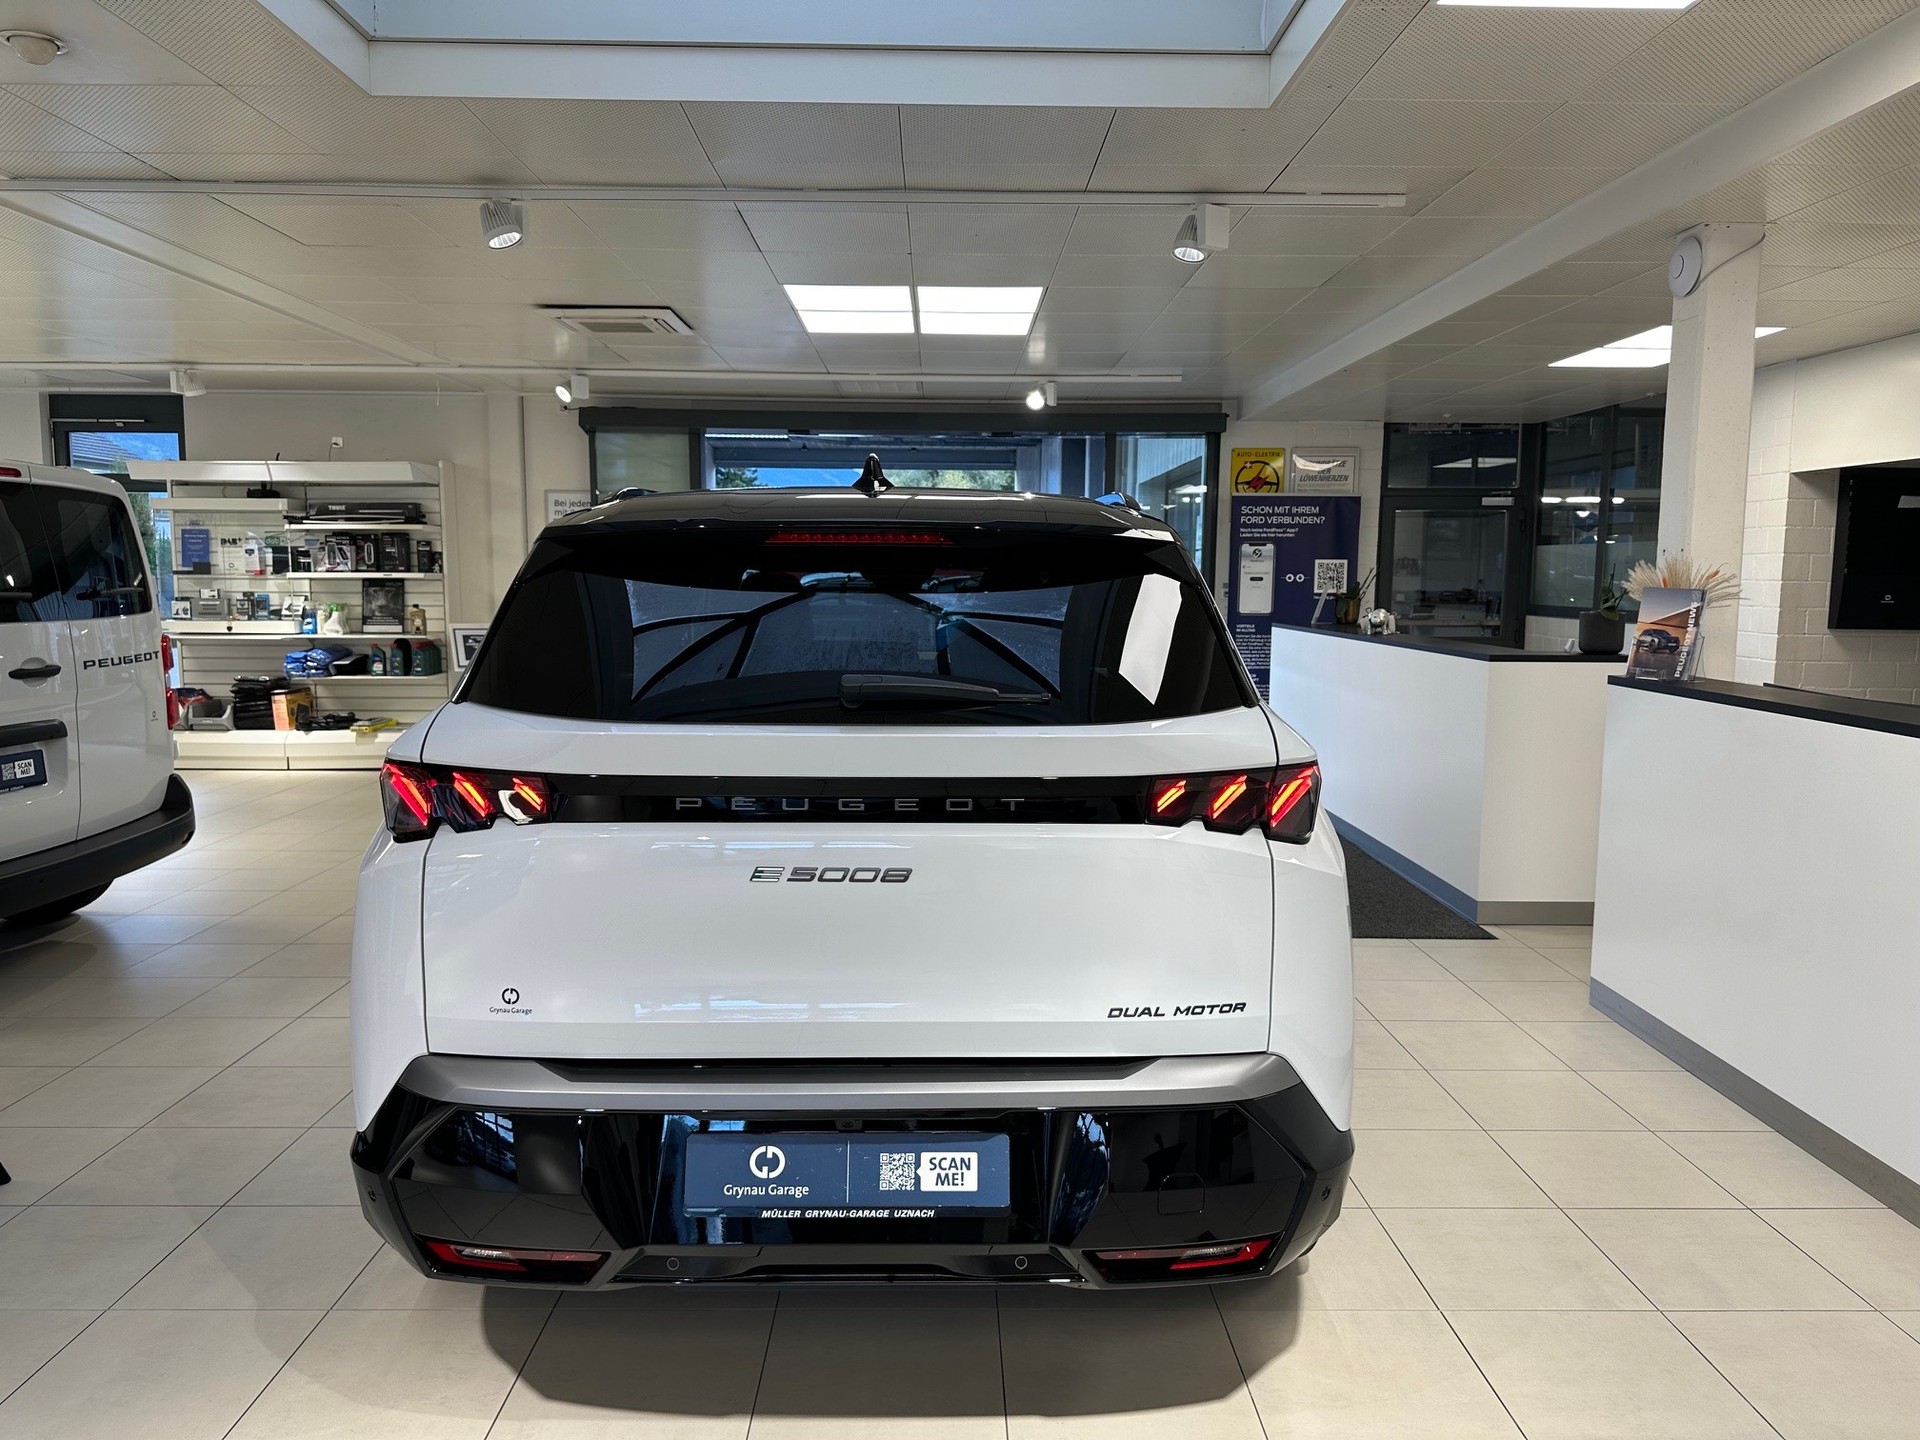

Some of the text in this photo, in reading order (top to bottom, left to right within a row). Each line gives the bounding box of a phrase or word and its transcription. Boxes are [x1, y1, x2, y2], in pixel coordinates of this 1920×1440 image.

[1241, 506, 1319, 514] SCHON MIT IHREM
[1240, 516, 1326, 524] FORD VERBUNDEN?
[1674, 602, 1698, 677] PEUGEOT NEWS
[83, 651, 159, 670] PEUGEOT
[17, 761, 32, 769] SCAN
[675, 797, 1025, 811] PEUGEOT
[489, 1006, 532, 1015] Grynau Garage
[1107, 1002, 1247, 1018] DUAL MOTOR
[929, 1157, 971, 1171] SCAN
[935, 1172, 965, 1186] ME!
[723, 1184, 809, 1198] Grynau Garage
[761, 1208, 935, 1218] MÜLLER GRYNAU-GARAGE UZNACH
